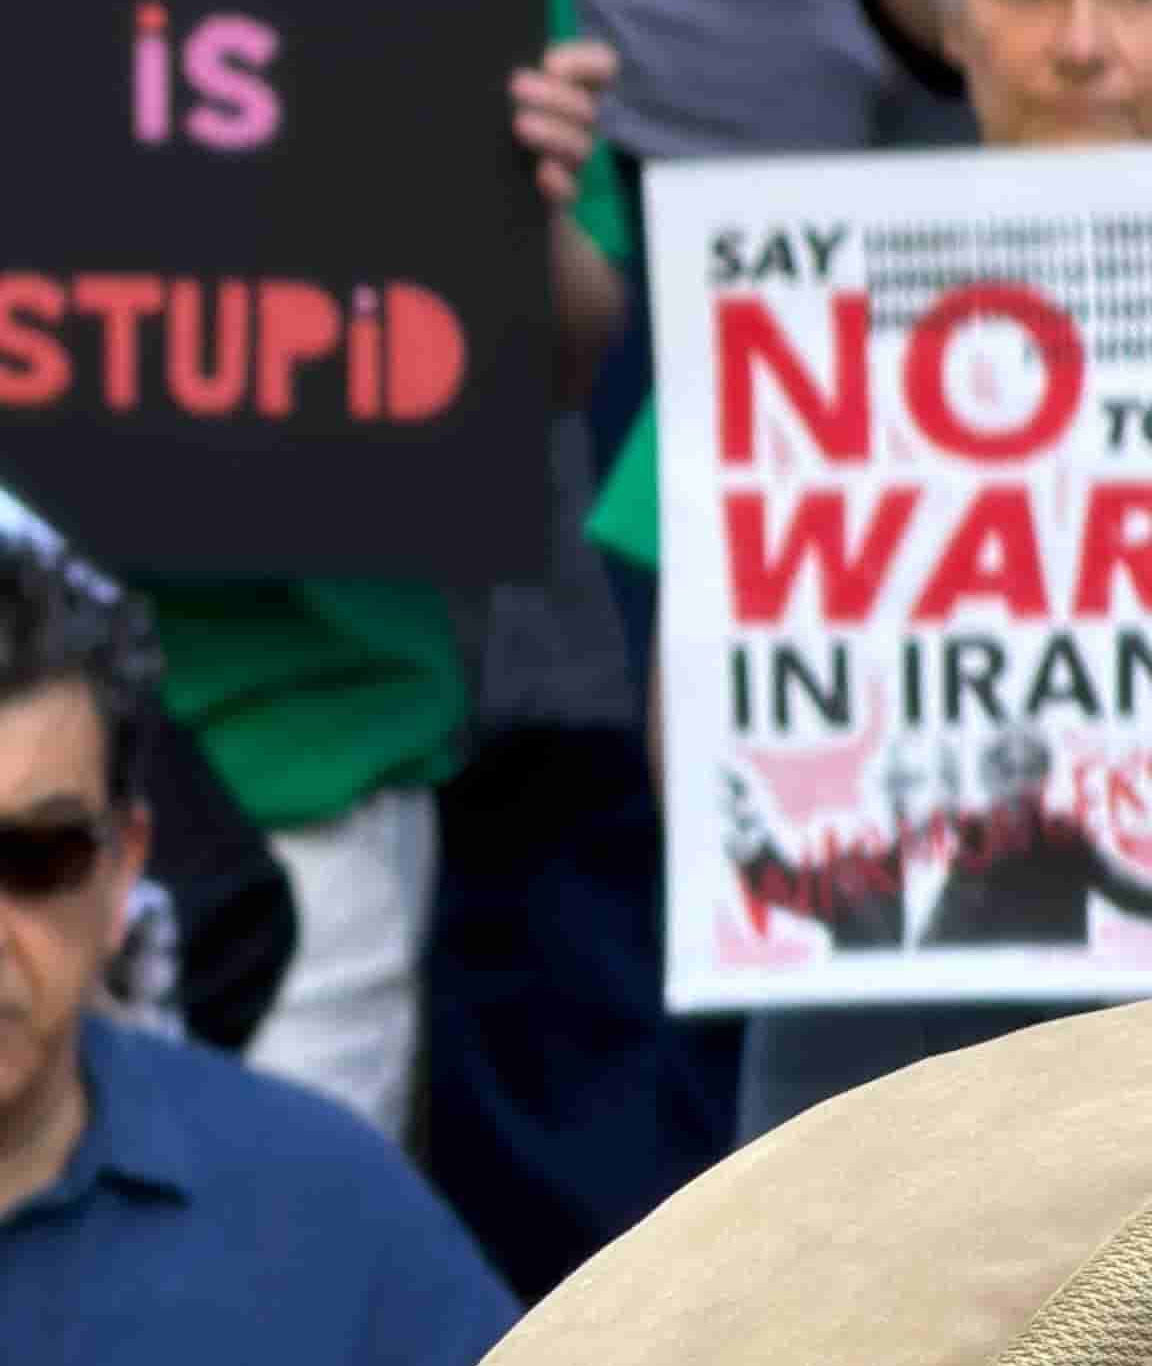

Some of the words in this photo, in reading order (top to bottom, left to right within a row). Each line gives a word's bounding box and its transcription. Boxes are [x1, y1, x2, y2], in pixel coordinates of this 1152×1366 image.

[711, 224, 848, 285] SAY
[714, 281, 1085, 467] NO
[720, 480, 1152, 626] WAR
[727, 637, 853, 733] IN
